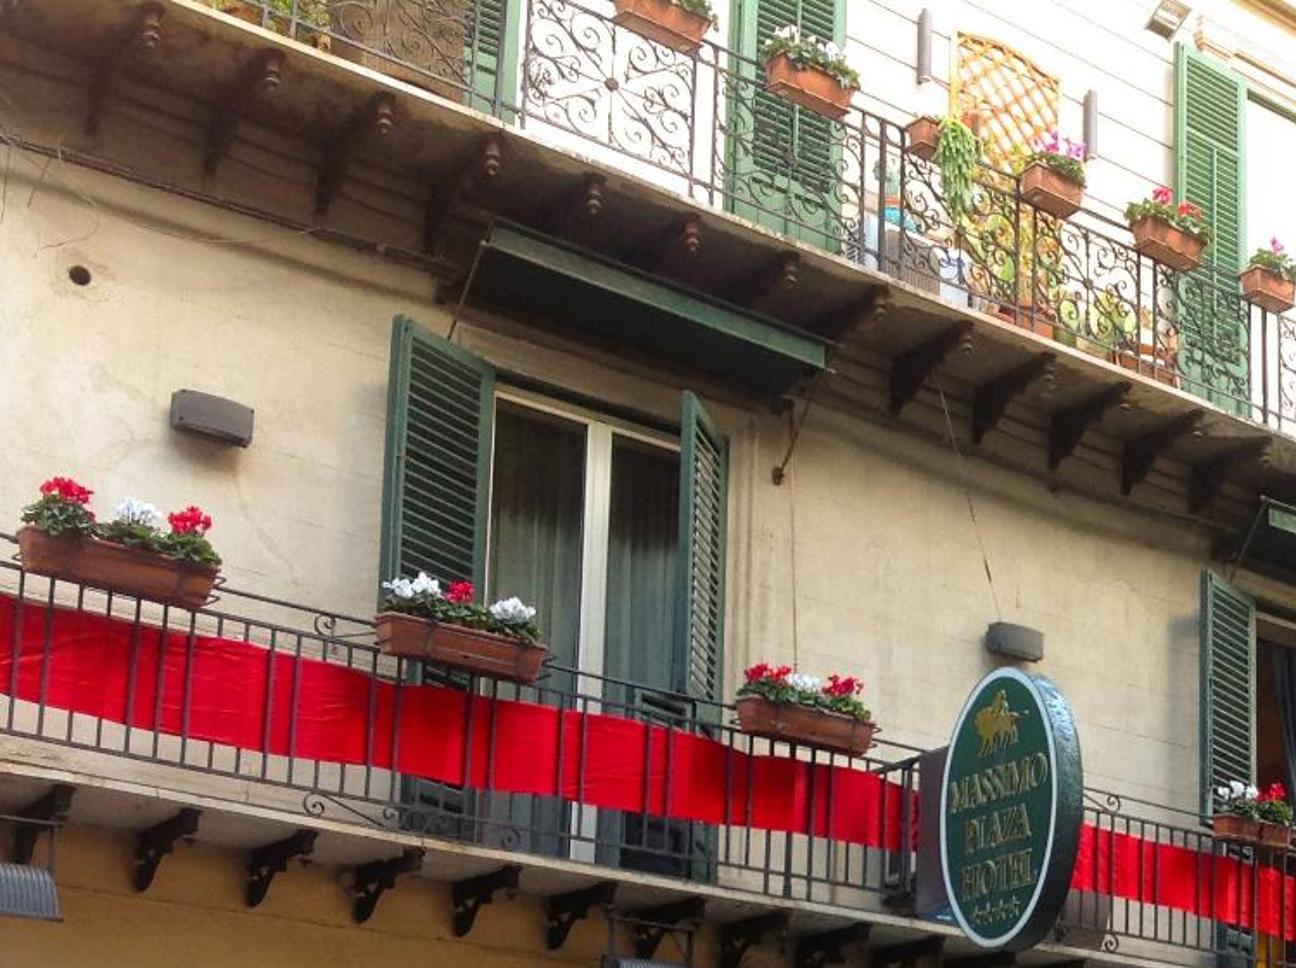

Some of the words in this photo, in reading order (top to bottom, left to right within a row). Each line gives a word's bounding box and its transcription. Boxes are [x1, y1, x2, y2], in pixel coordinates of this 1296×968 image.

[950, 752, 1049, 814] MASSIMO
[964, 803, 1032, 854] PLAZA
[961, 848, 1038, 900] HOTEL
